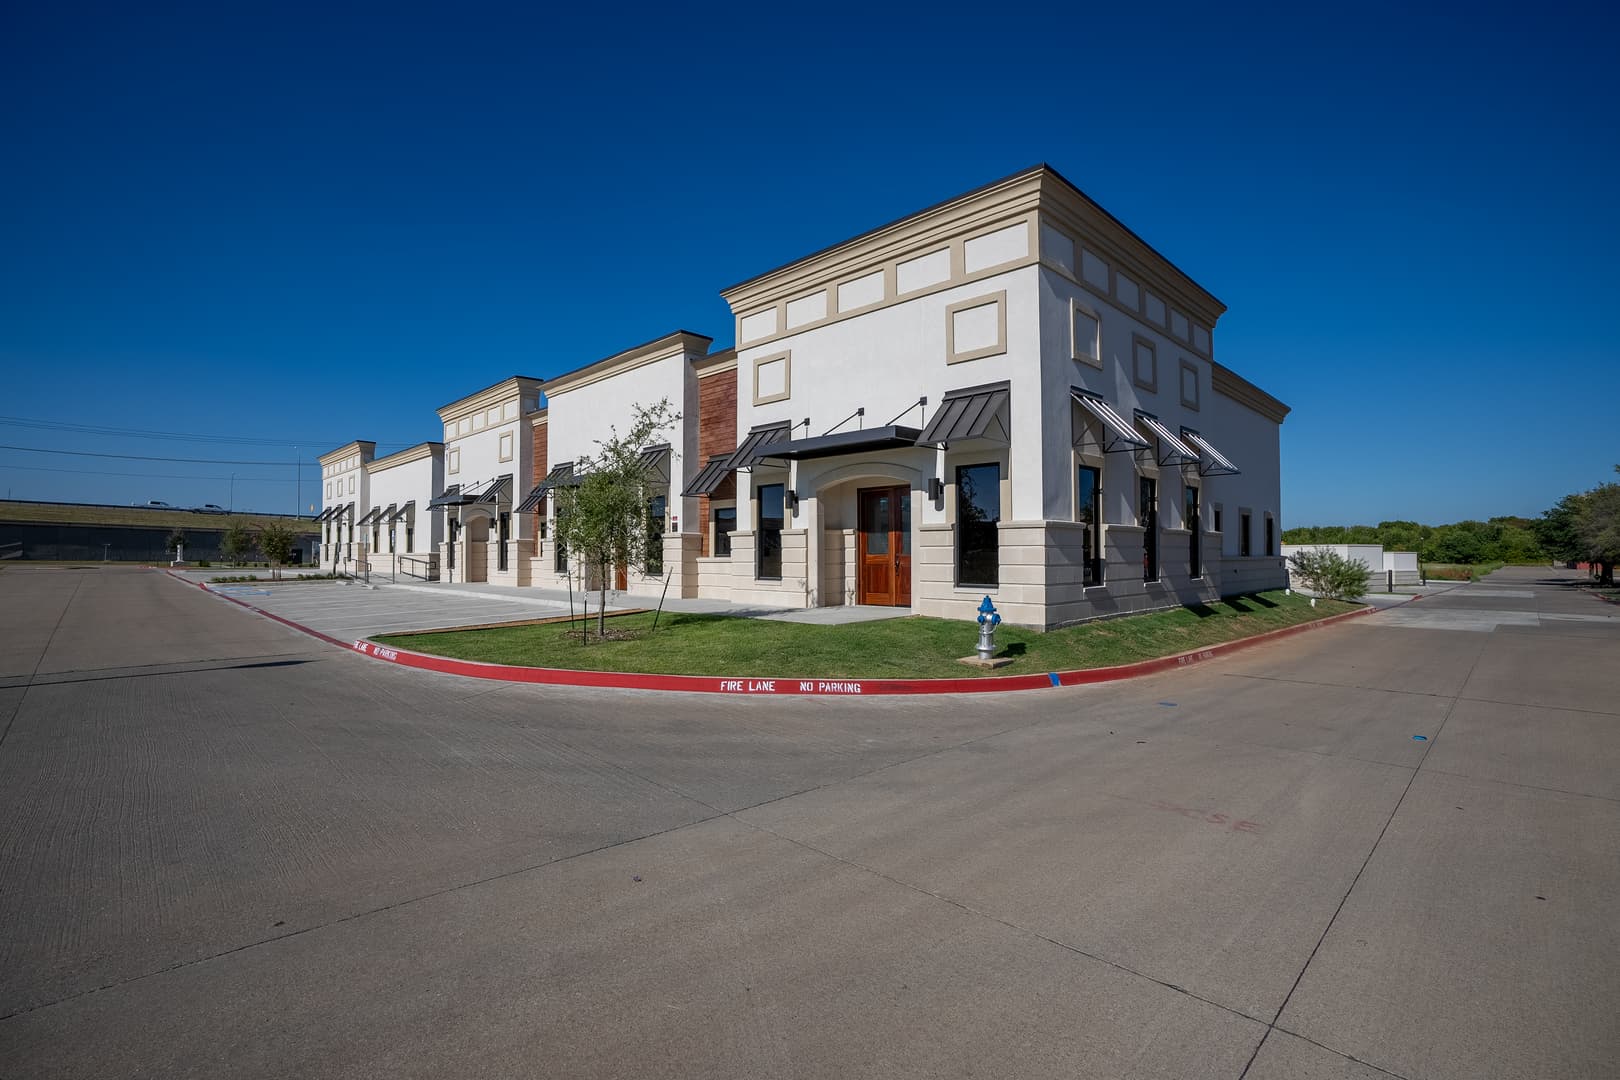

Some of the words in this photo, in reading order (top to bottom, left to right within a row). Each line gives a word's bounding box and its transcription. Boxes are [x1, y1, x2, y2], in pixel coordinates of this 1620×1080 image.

[720, 681, 744, 691] FIRE
[748, 681, 776, 691] LANE
[800, 682, 813, 691] NO
[818, 682, 861, 693] PARKING
